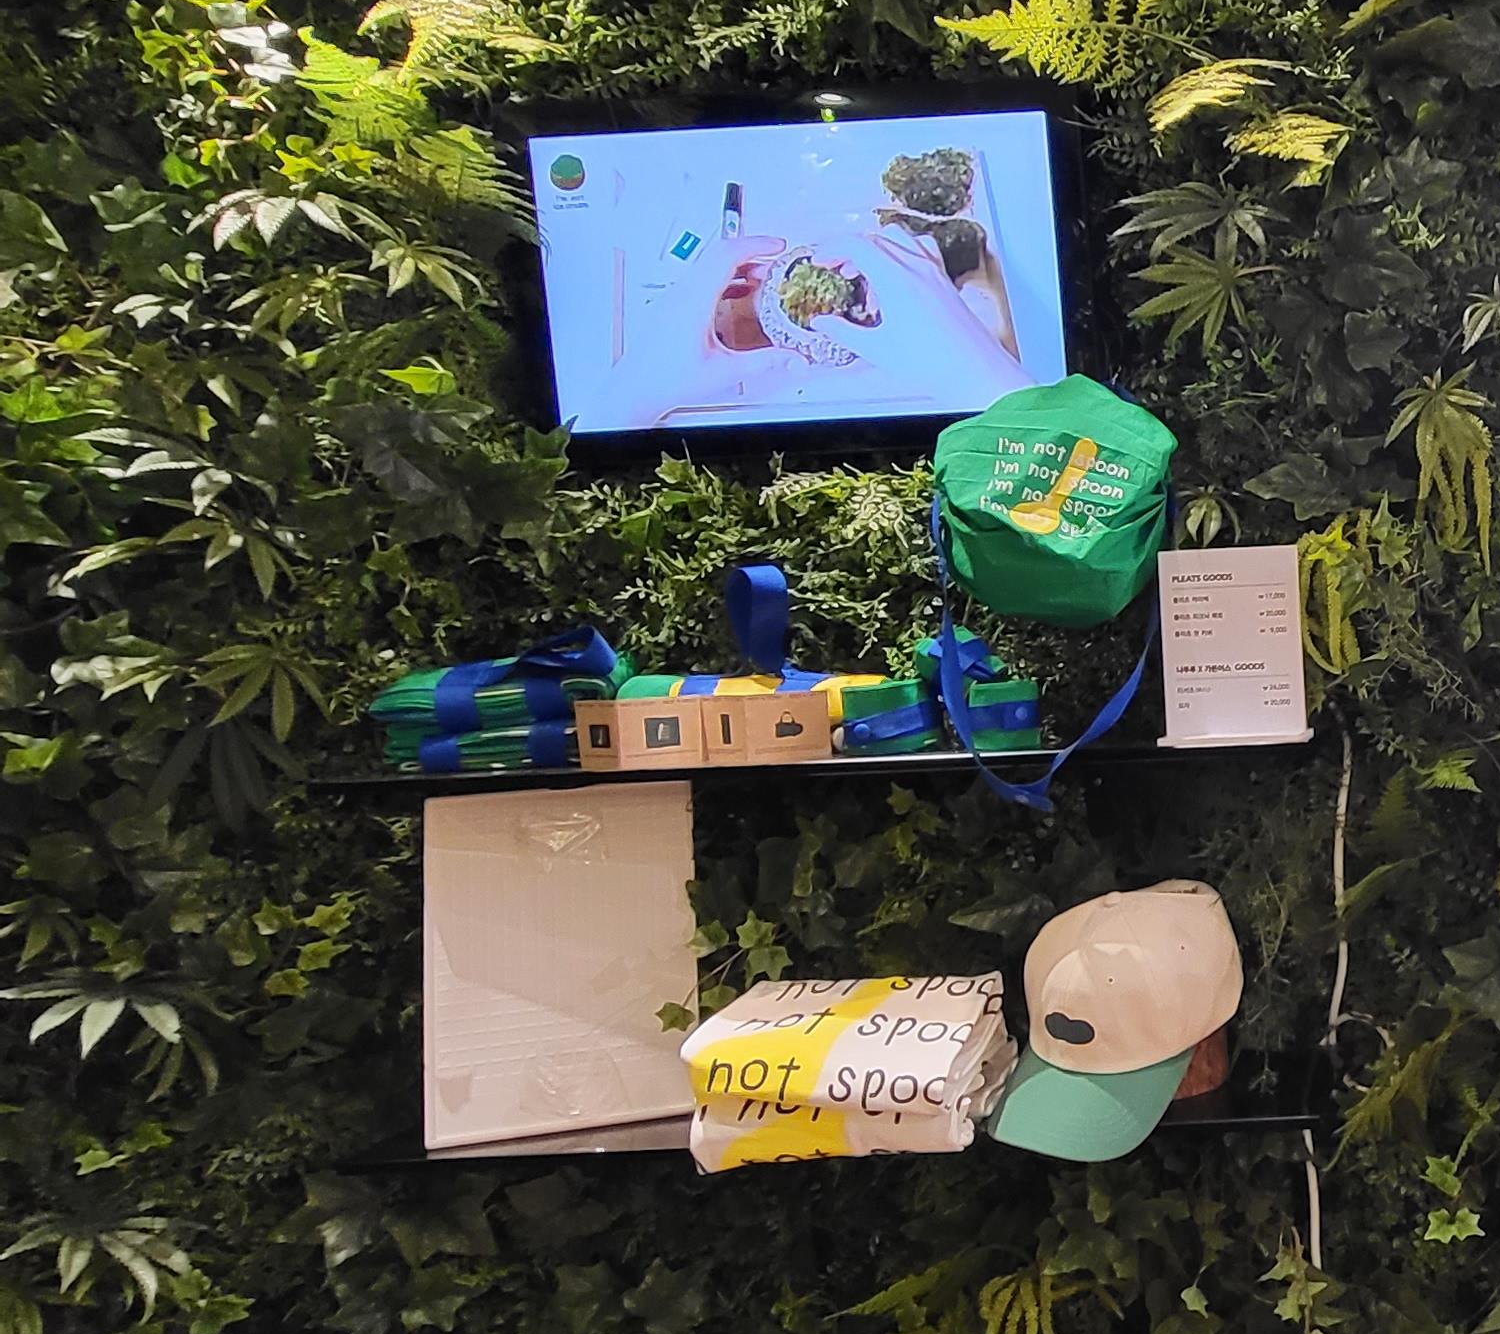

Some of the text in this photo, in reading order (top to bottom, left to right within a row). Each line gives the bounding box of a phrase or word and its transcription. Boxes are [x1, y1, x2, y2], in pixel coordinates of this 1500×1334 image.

[997, 437, 1025, 455] I'm
[1033, 442, 1067, 463] not
[993, 460, 1124, 499] I'm not spoon
[1171, 573, 1233, 583] PLEATS GOODS
[1234, 663, 1265, 671] GOODS
[706, 1057, 800, 1101] not
